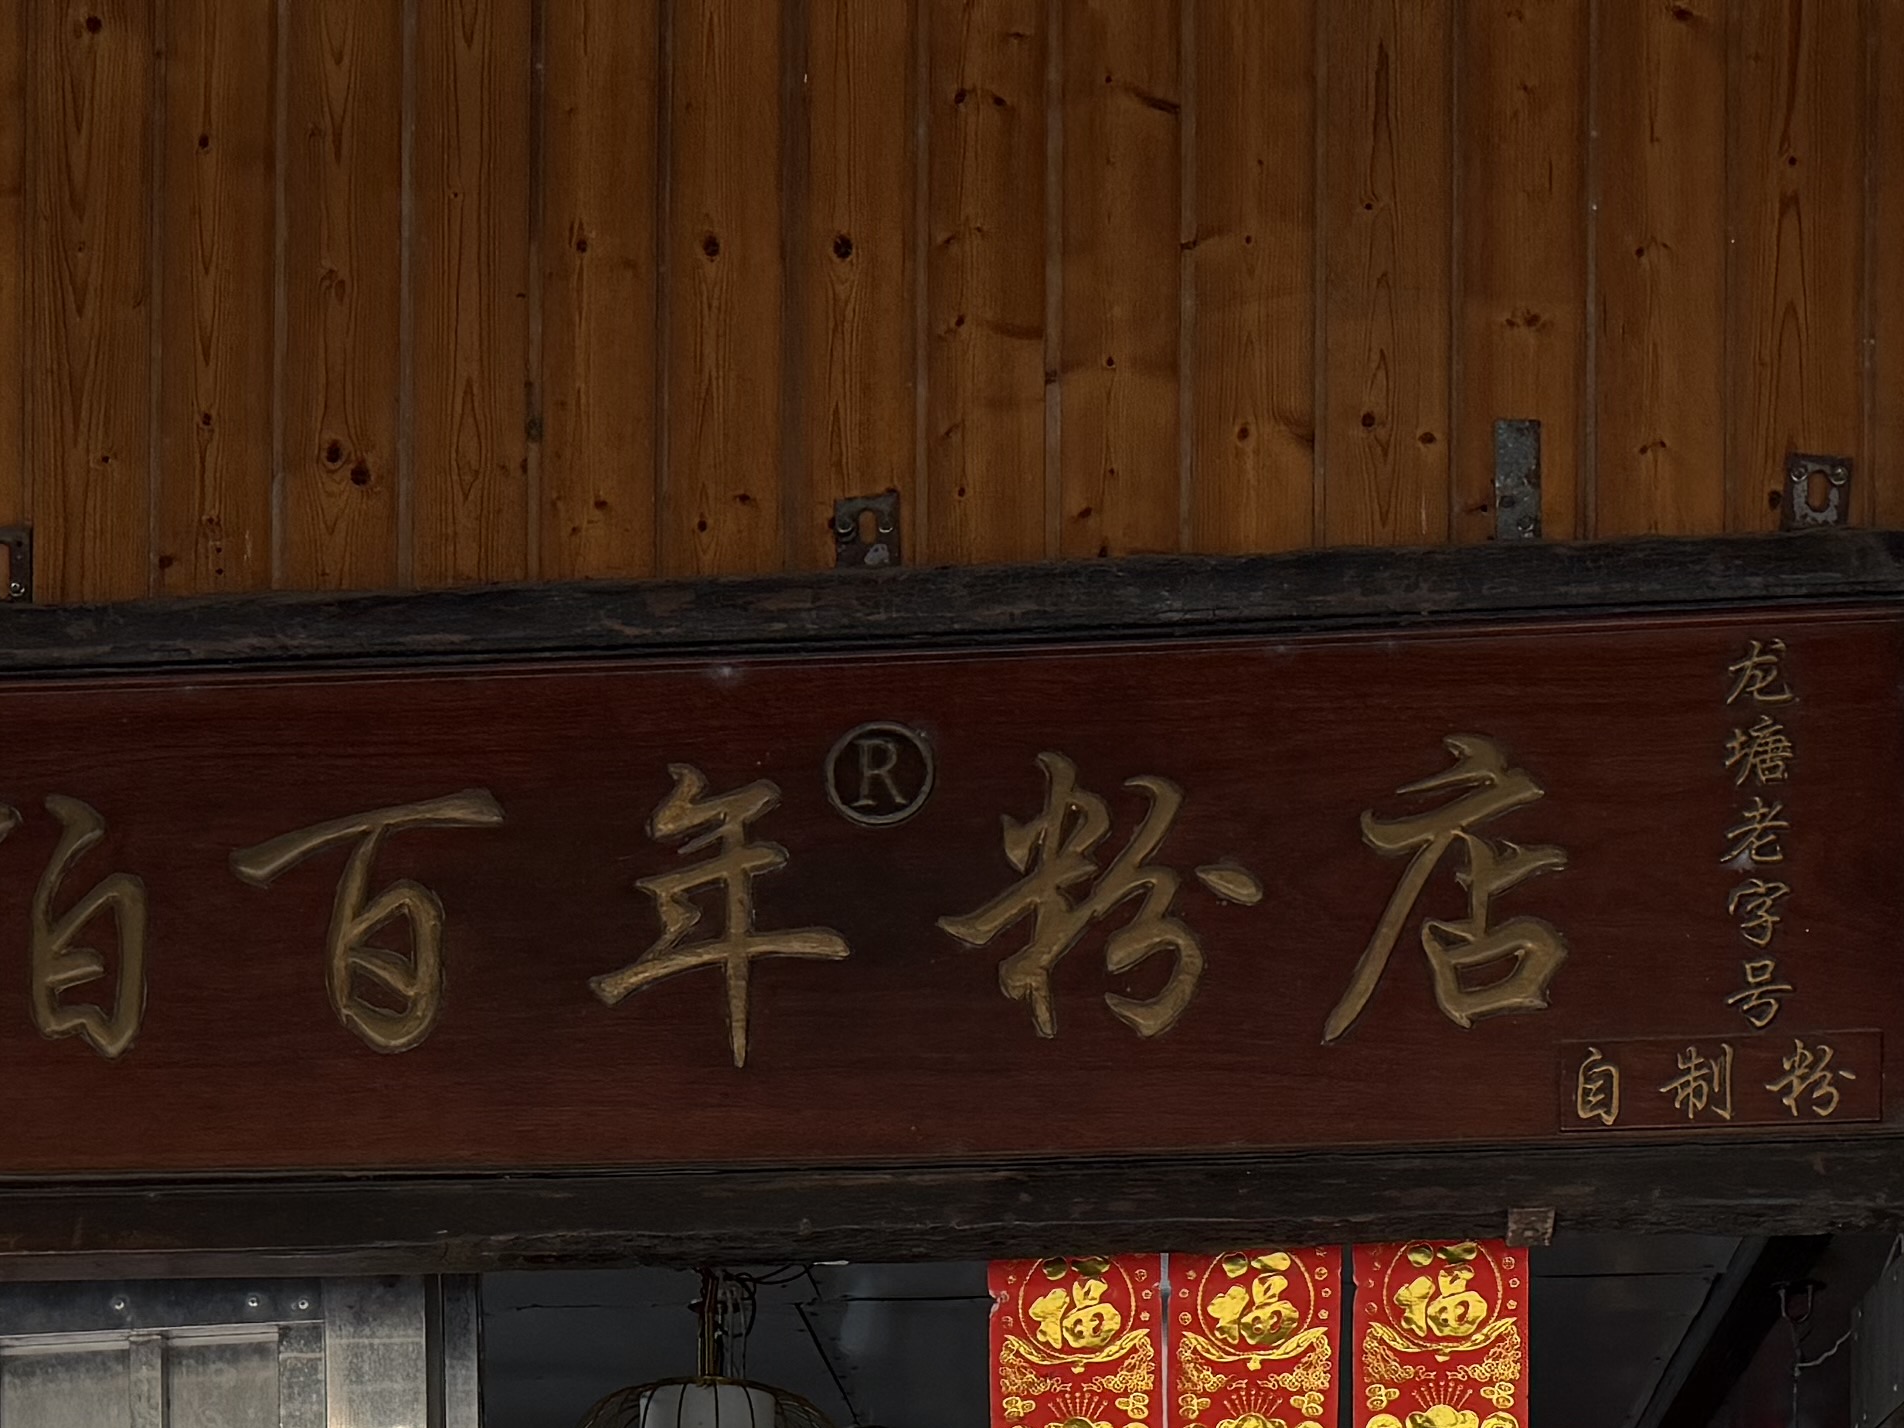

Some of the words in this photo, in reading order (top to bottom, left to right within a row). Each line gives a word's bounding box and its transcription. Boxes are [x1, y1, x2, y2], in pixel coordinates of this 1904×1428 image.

[1720, 638, 1800, 1027] 龙塘老字号
[1576, 1039, 1856, 1126] 自制粉
[1028, 1255, 1122, 1348] 福
[1207, 1252, 1298, 1346] 福
[1393, 1242, 1488, 1337] 福
